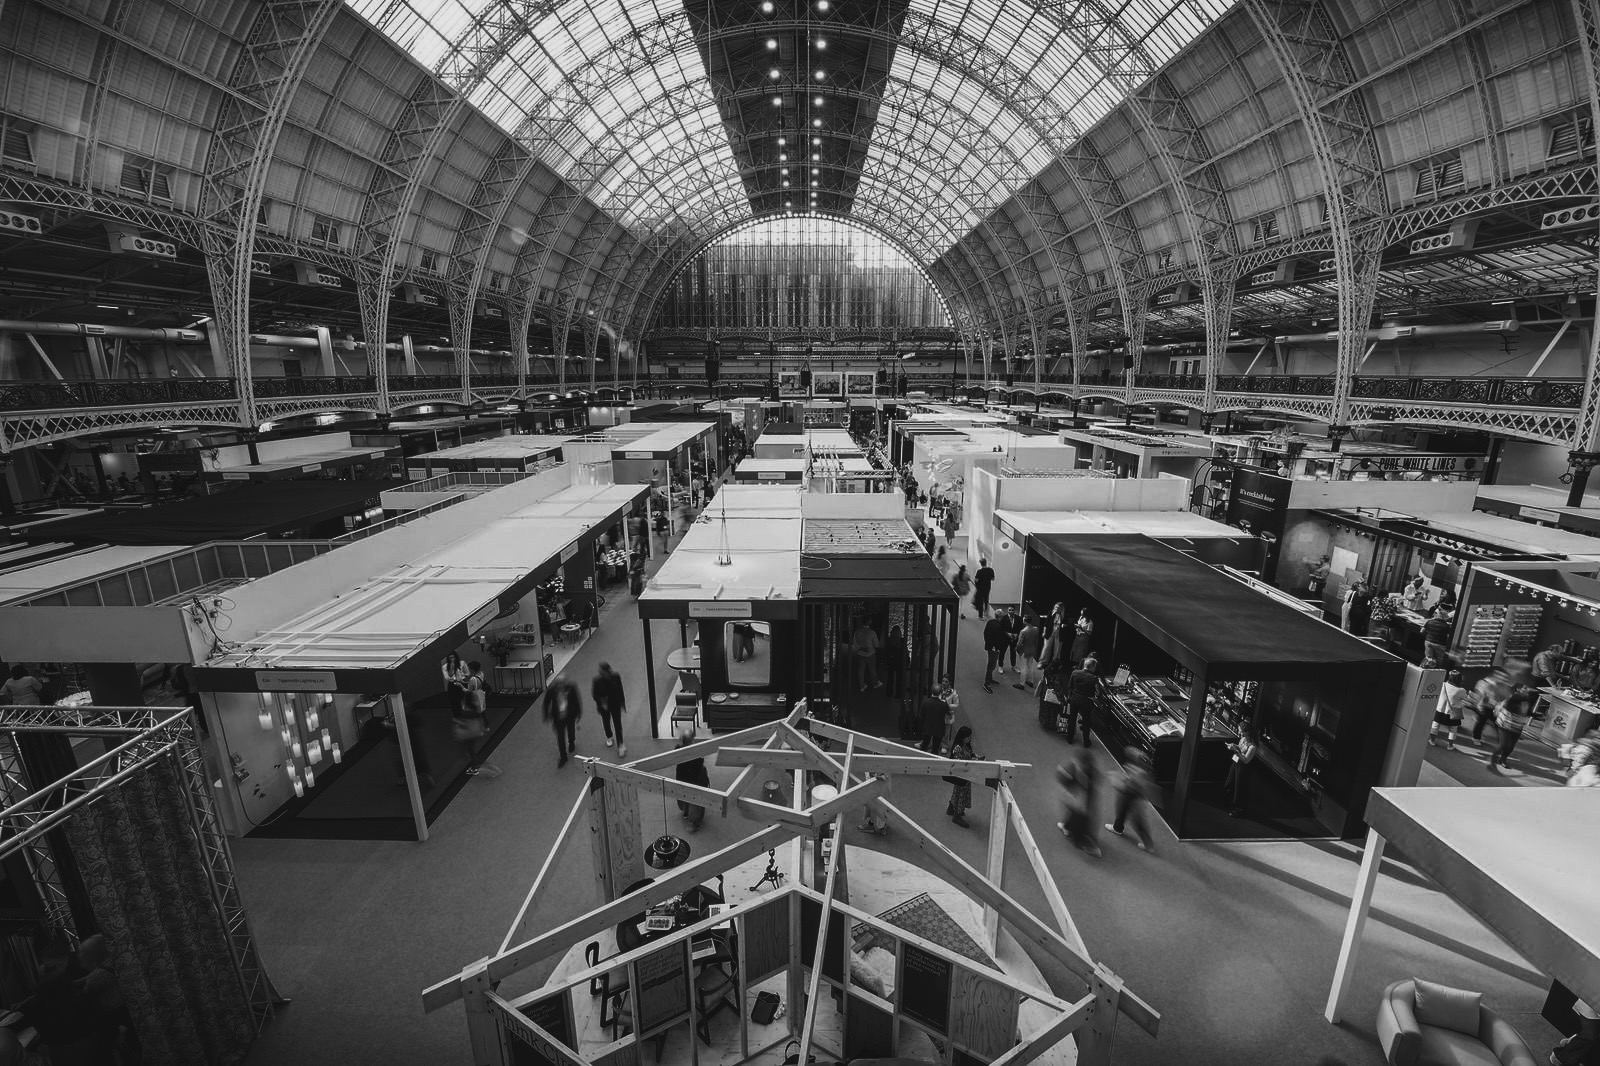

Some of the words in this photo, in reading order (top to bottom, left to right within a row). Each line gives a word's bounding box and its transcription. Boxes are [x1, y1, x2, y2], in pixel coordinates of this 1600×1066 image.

[1380, 457, 1401, 471] PURE
[1403, 457, 1432, 471] WHITE
[1432, 457, 1457, 471] LINES
